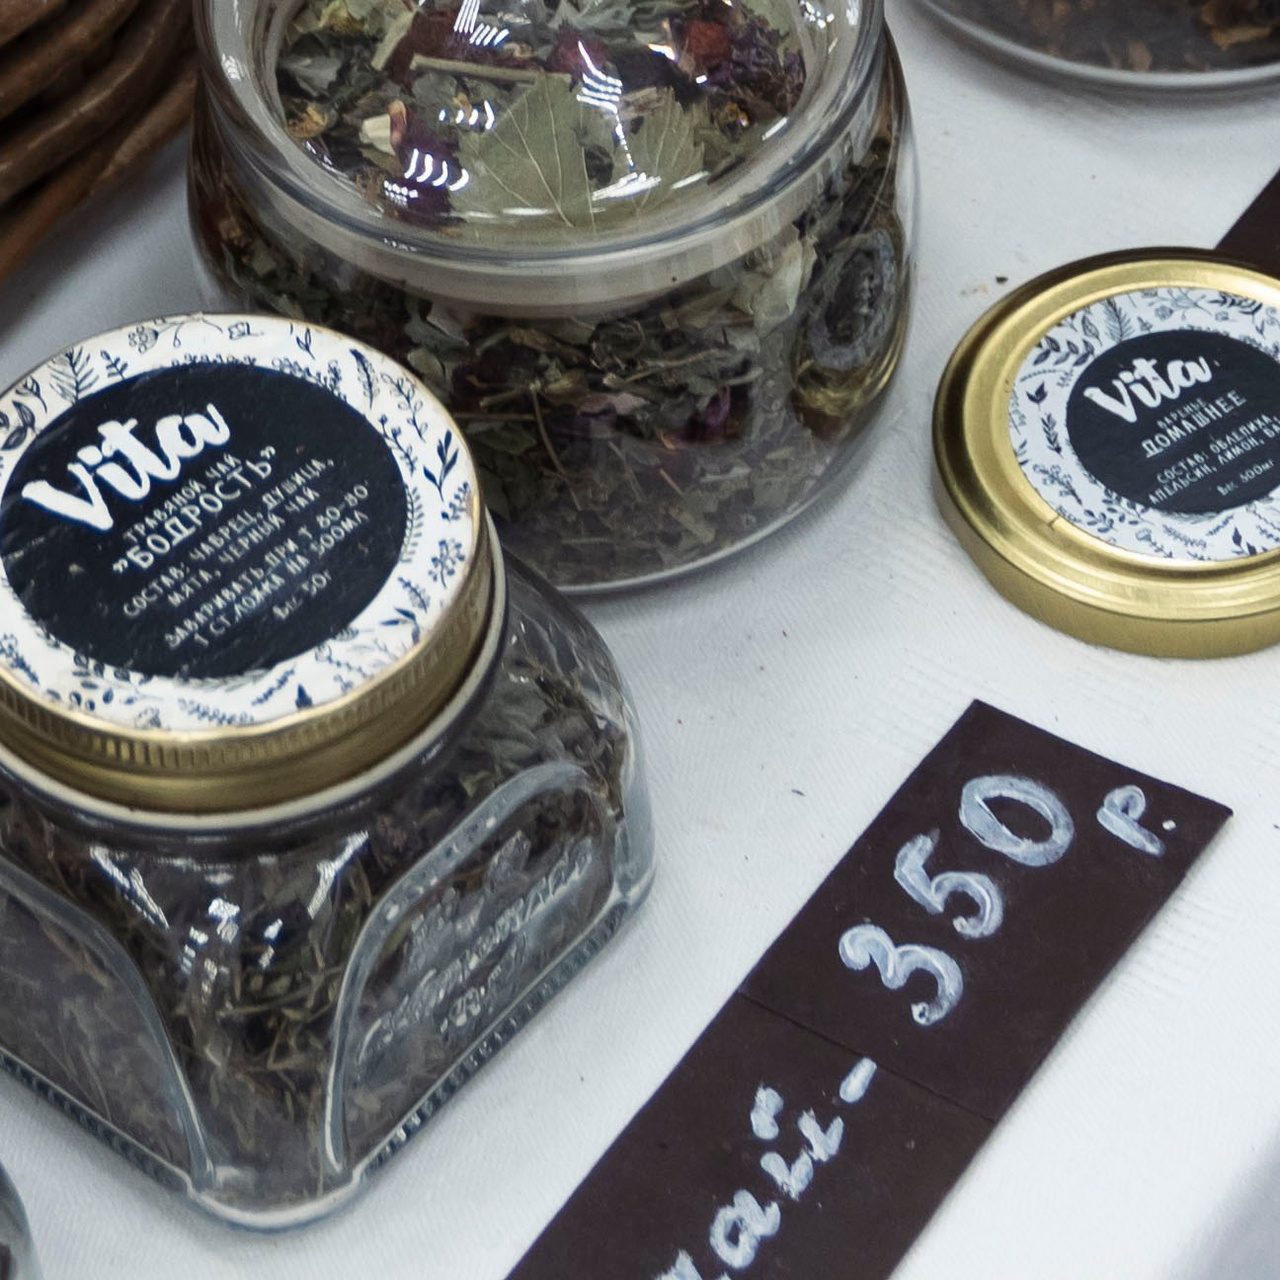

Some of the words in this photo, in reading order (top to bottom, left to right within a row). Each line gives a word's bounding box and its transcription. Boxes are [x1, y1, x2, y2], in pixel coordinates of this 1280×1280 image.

[1084, 354, 1213, 425] Vita
[1141, 389, 1248, 459] ДОМАШНЕЕ
[22, 403, 231, 532] Vita
[122, 478, 206, 543] ТРАВЯНОЙ
[204, 452, 241, 480] ЧАЙ
[1148, 463, 1218, 505] АПЕЛЬСИН,
[1217, 436, 1265, 466] ЛИМОН,
[1156, 450, 1209, 484] СОСТАВ:
[123, 561, 191, 618] СОСТАВ:
[189, 509, 265, 562] ЧАБРЕЦ,
[261, 457, 335, 511] ДУШИЦА,
[167, 569, 222, 608] МЯТА,
[218, 512, 286, 564] ЧЕРНЫЙ
[285, 486, 320, 514] ЧАЙ
[285, 553, 310, 575] НА
[165, 566, 265, 648] ЗАВАРИВАТЬ
[265, 538, 299, 568] ПРИ
[838, 774, 1075, 1026] 350
